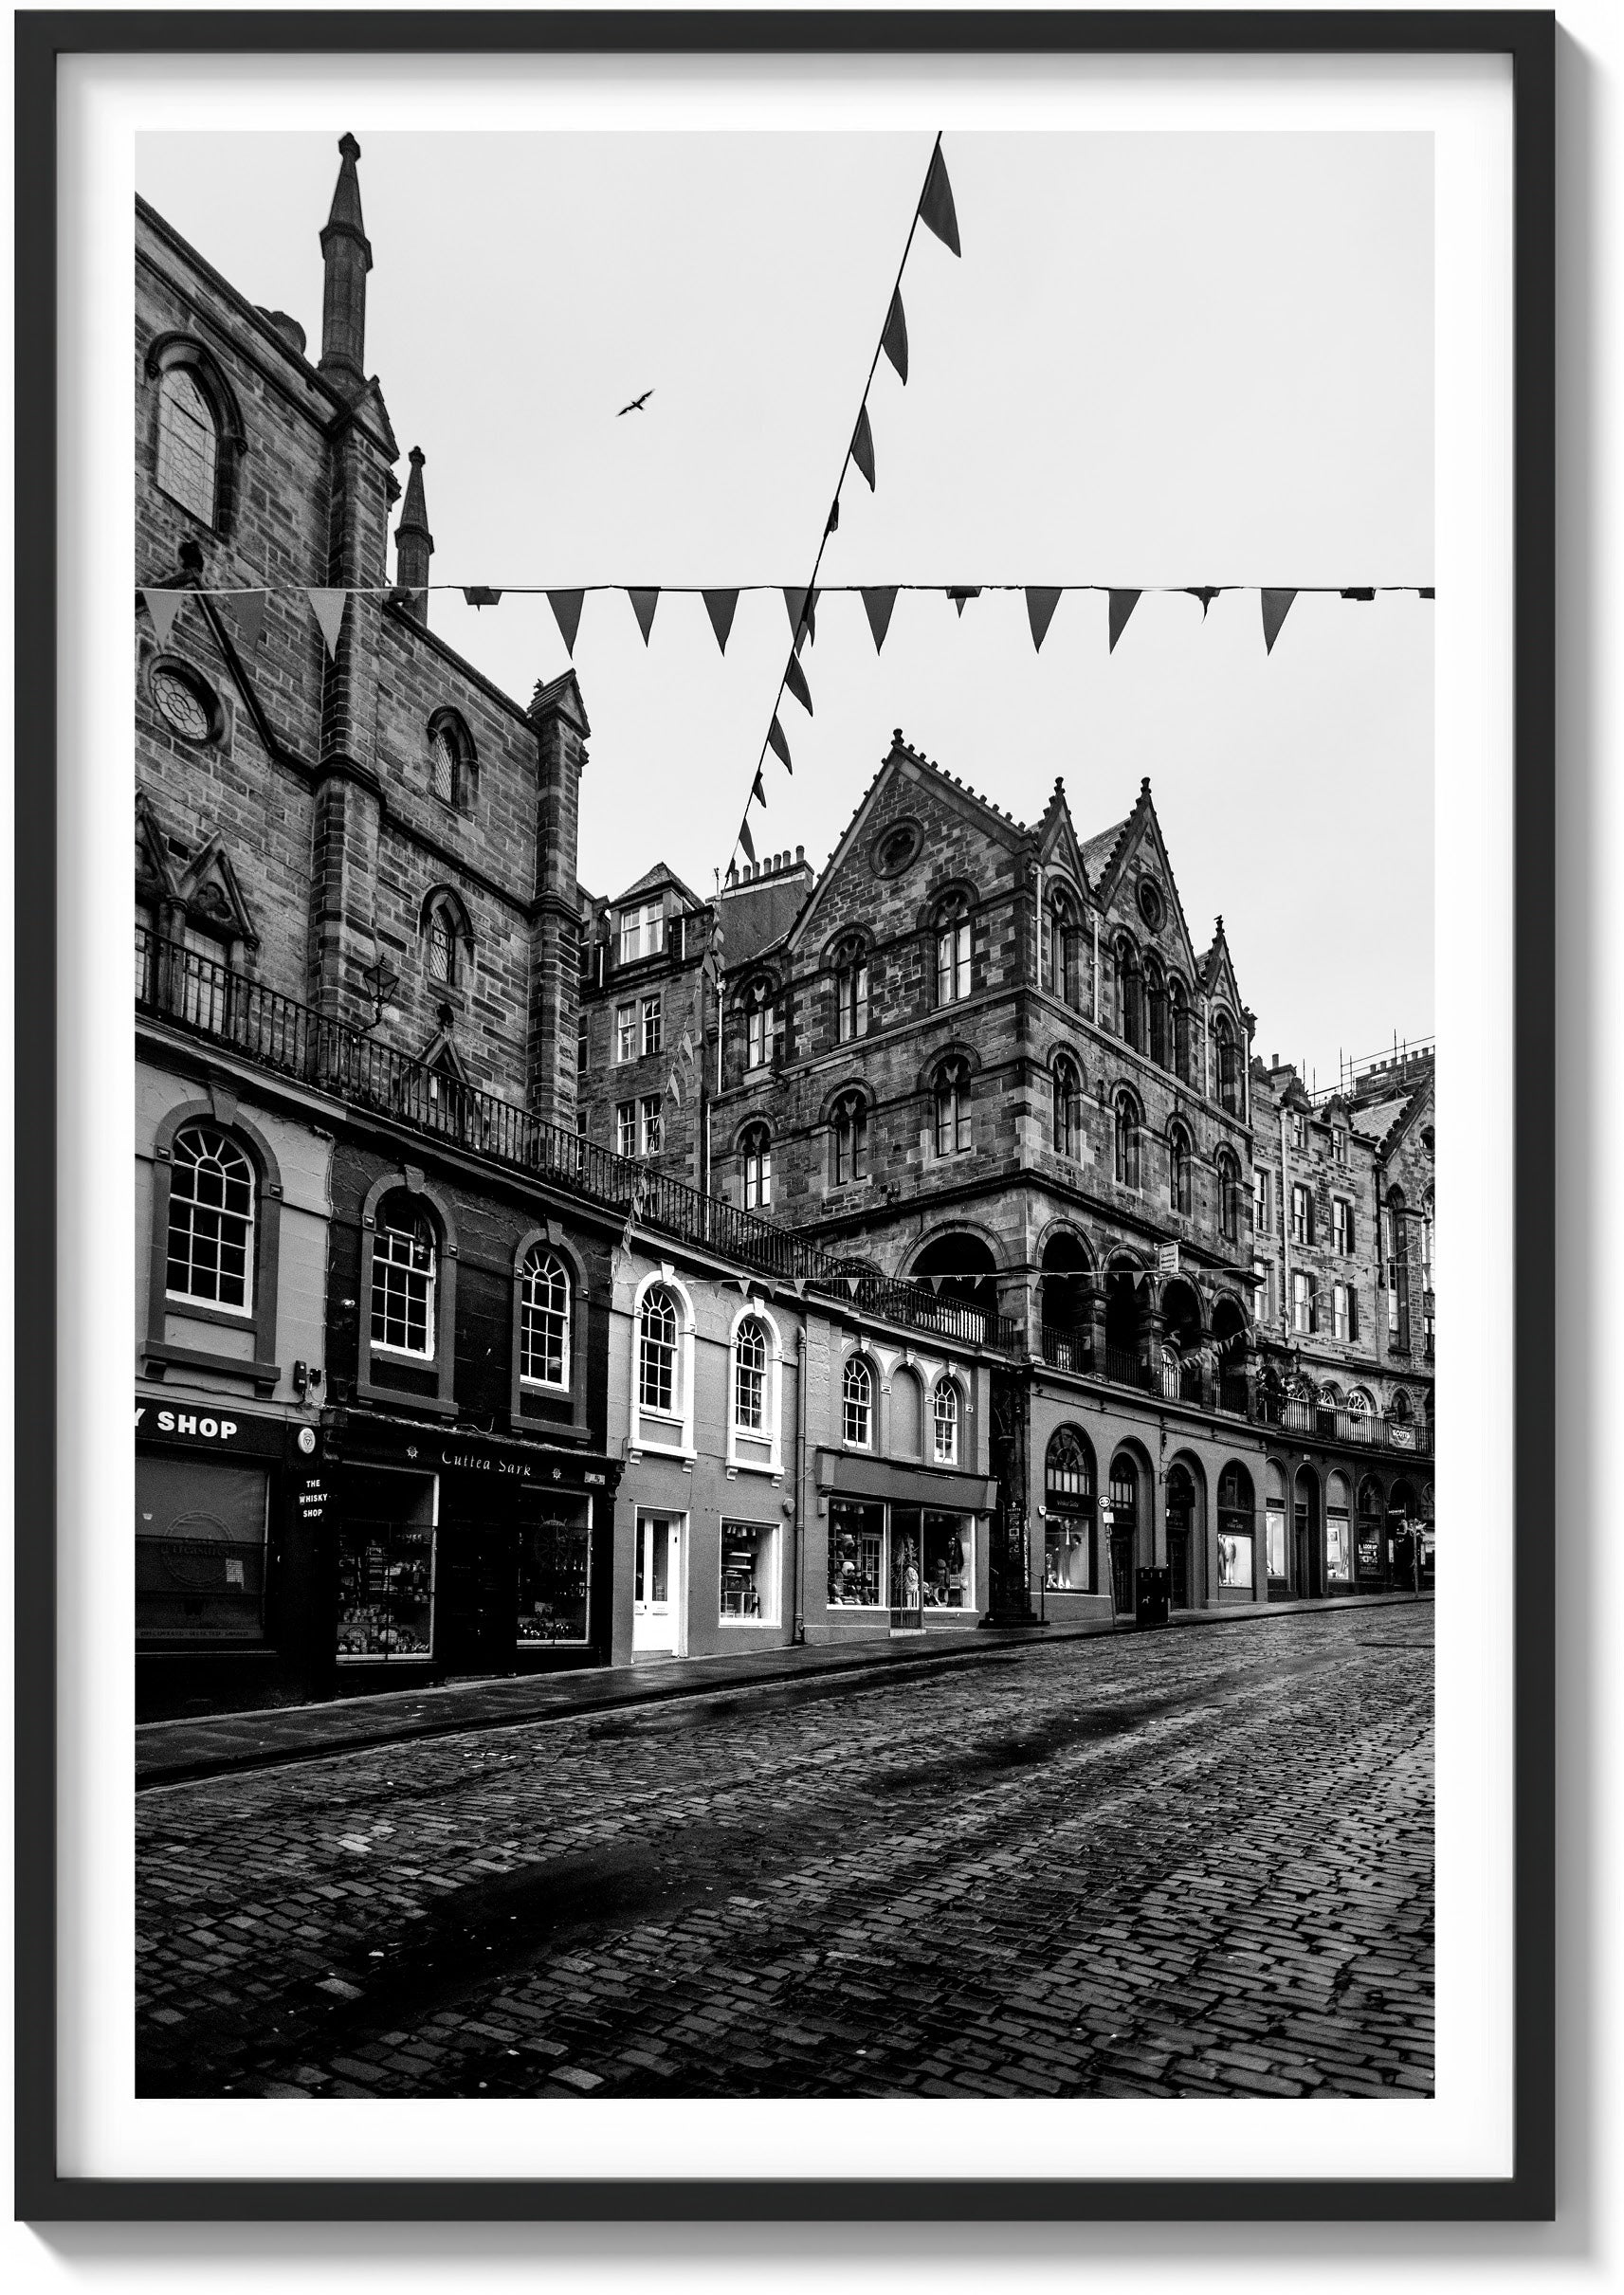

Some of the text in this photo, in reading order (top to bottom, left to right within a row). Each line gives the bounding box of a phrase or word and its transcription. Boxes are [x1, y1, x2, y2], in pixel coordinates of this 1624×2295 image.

[156, 1411, 238, 1439] SHOP
[442, 1450, 531, 1476] Cuttea Sark
[305, 1479, 320, 1488] THE
[299, 1493, 328, 1503] WHISKY
[302, 1508, 323, 1518] SHOP
